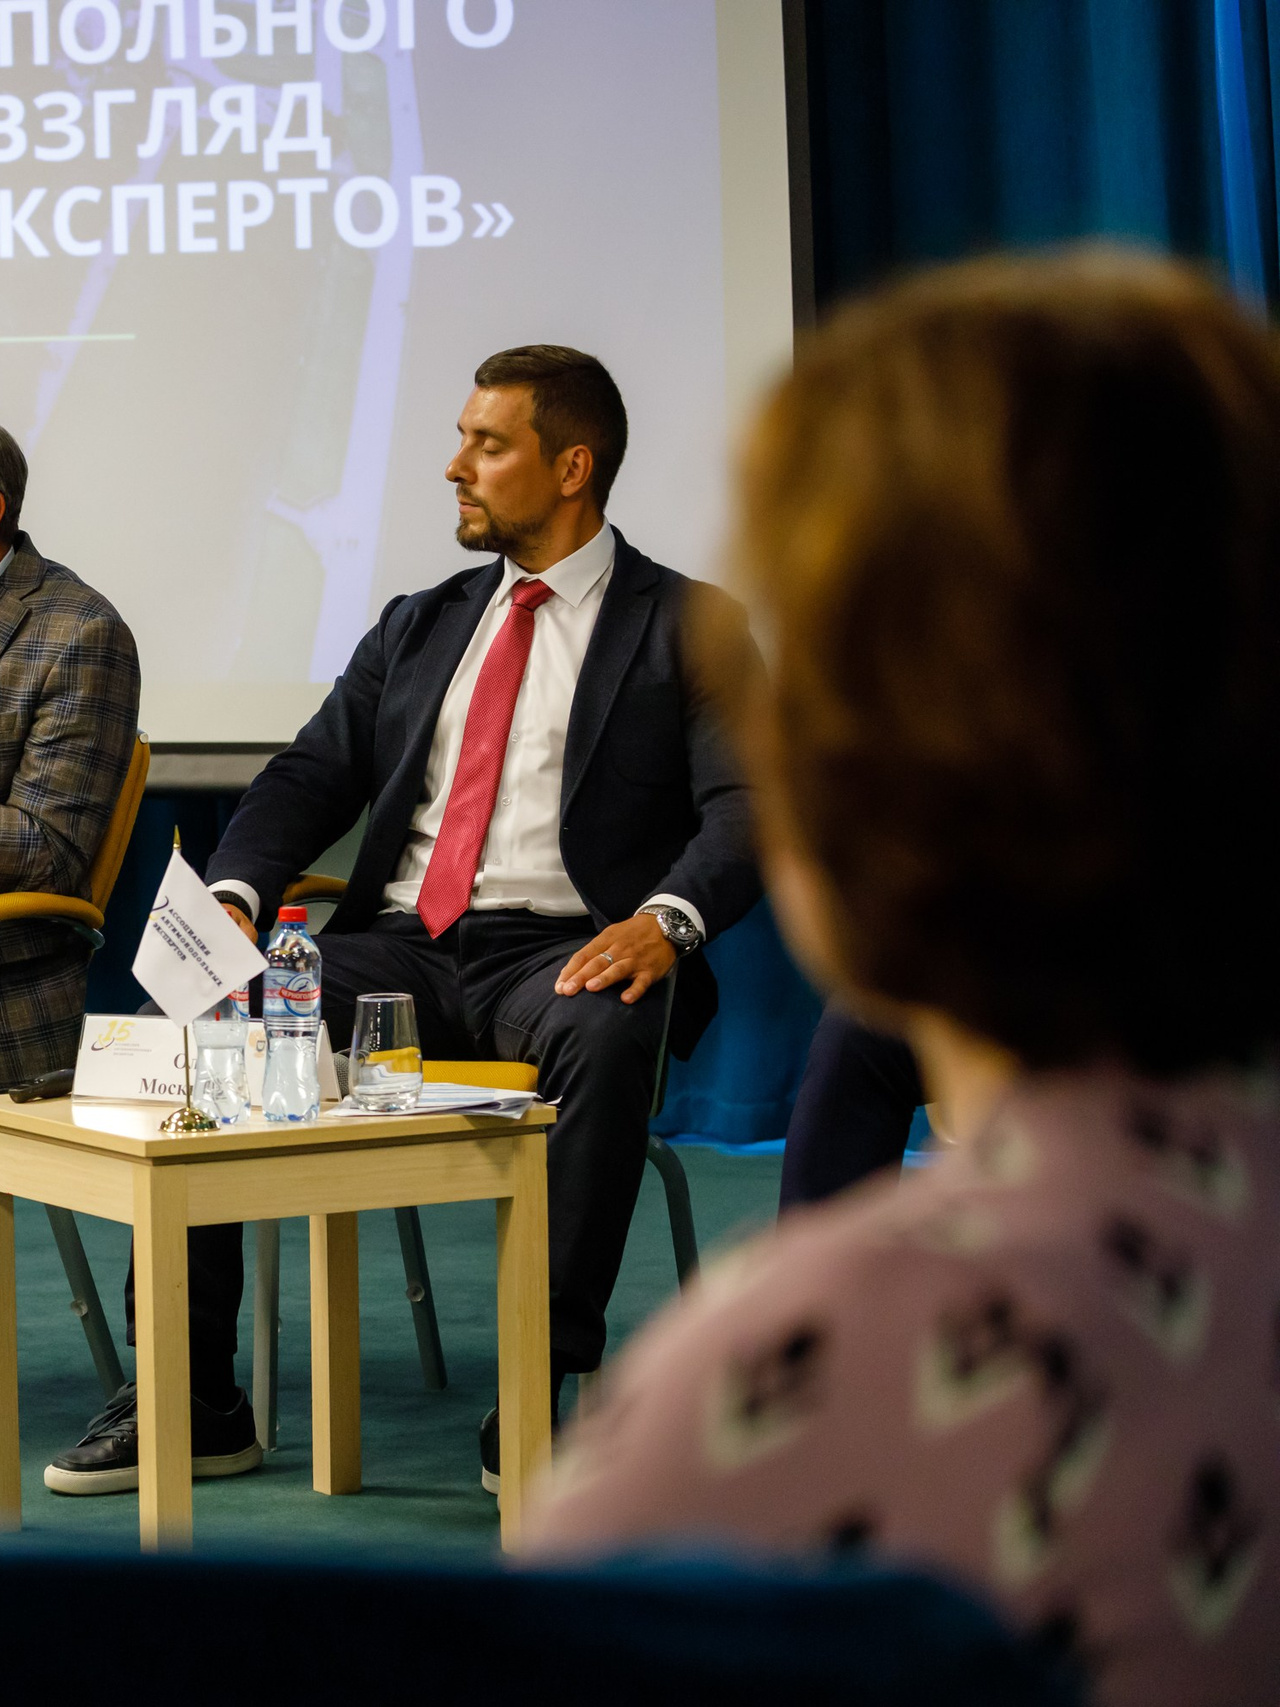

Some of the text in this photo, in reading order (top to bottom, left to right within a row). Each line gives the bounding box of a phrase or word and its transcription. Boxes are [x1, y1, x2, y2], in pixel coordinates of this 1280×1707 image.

[153, 922, 187, 961] ЭКСПЕРТОВ
[161, 916, 223, 987] АНТИМОНОПОЛЬНЫХ
[168, 908, 211, 956] АССОЦИАЦИЯ
[102, 1019, 137, 1042] 15
